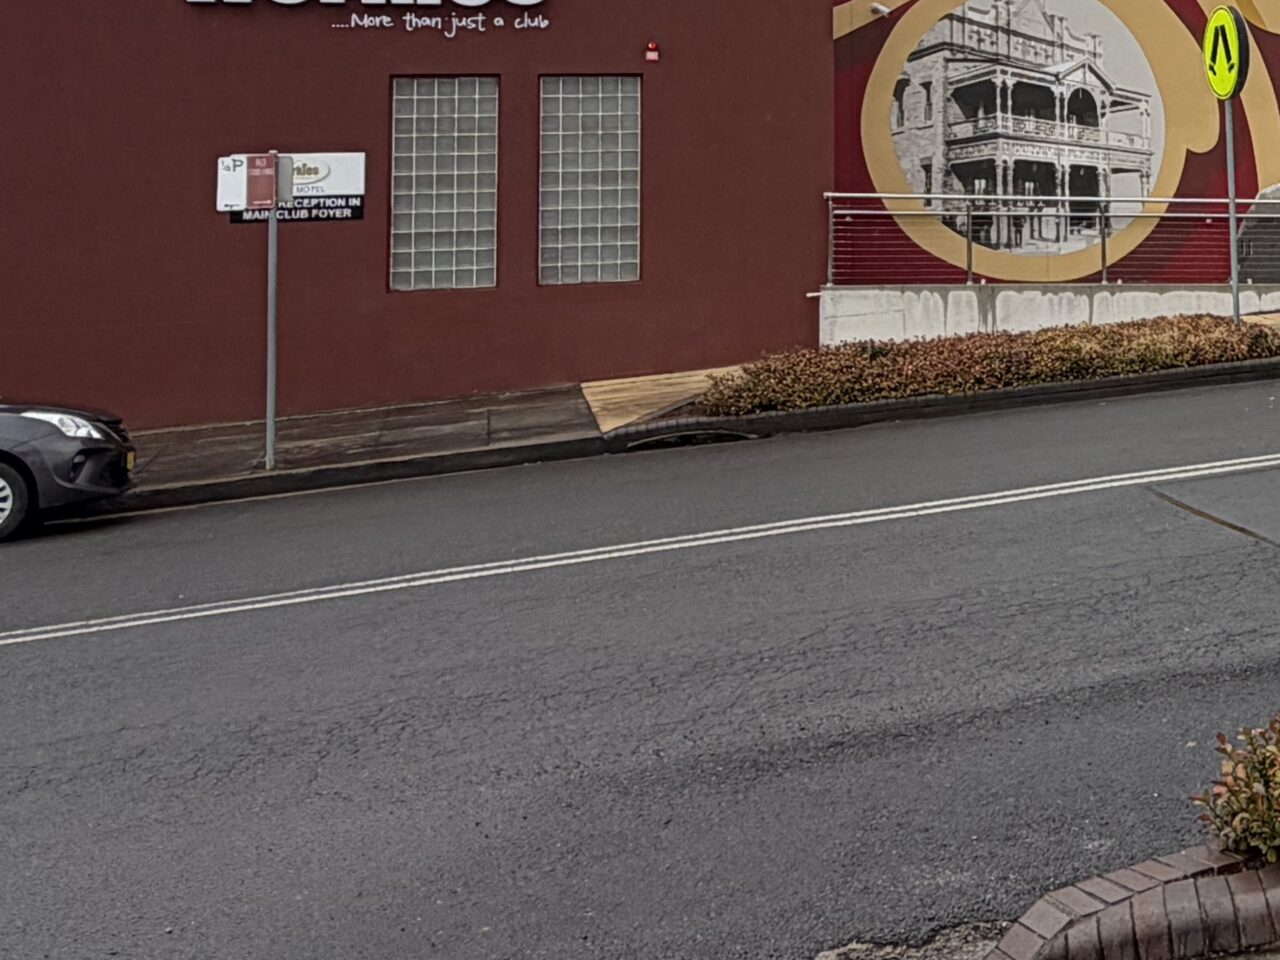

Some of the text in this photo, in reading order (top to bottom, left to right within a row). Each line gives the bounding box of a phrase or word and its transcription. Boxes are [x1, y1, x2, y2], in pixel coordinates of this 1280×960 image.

[402, 12, 443, 28] than
[445, 13, 486, 38] just
[494, 17, 504, 27] a
[514, 11, 550, 29] club
[348, 197, 361, 206] IN
[275, 209, 309, 219] CLUB
[311, 208, 352, 218] FOYER
